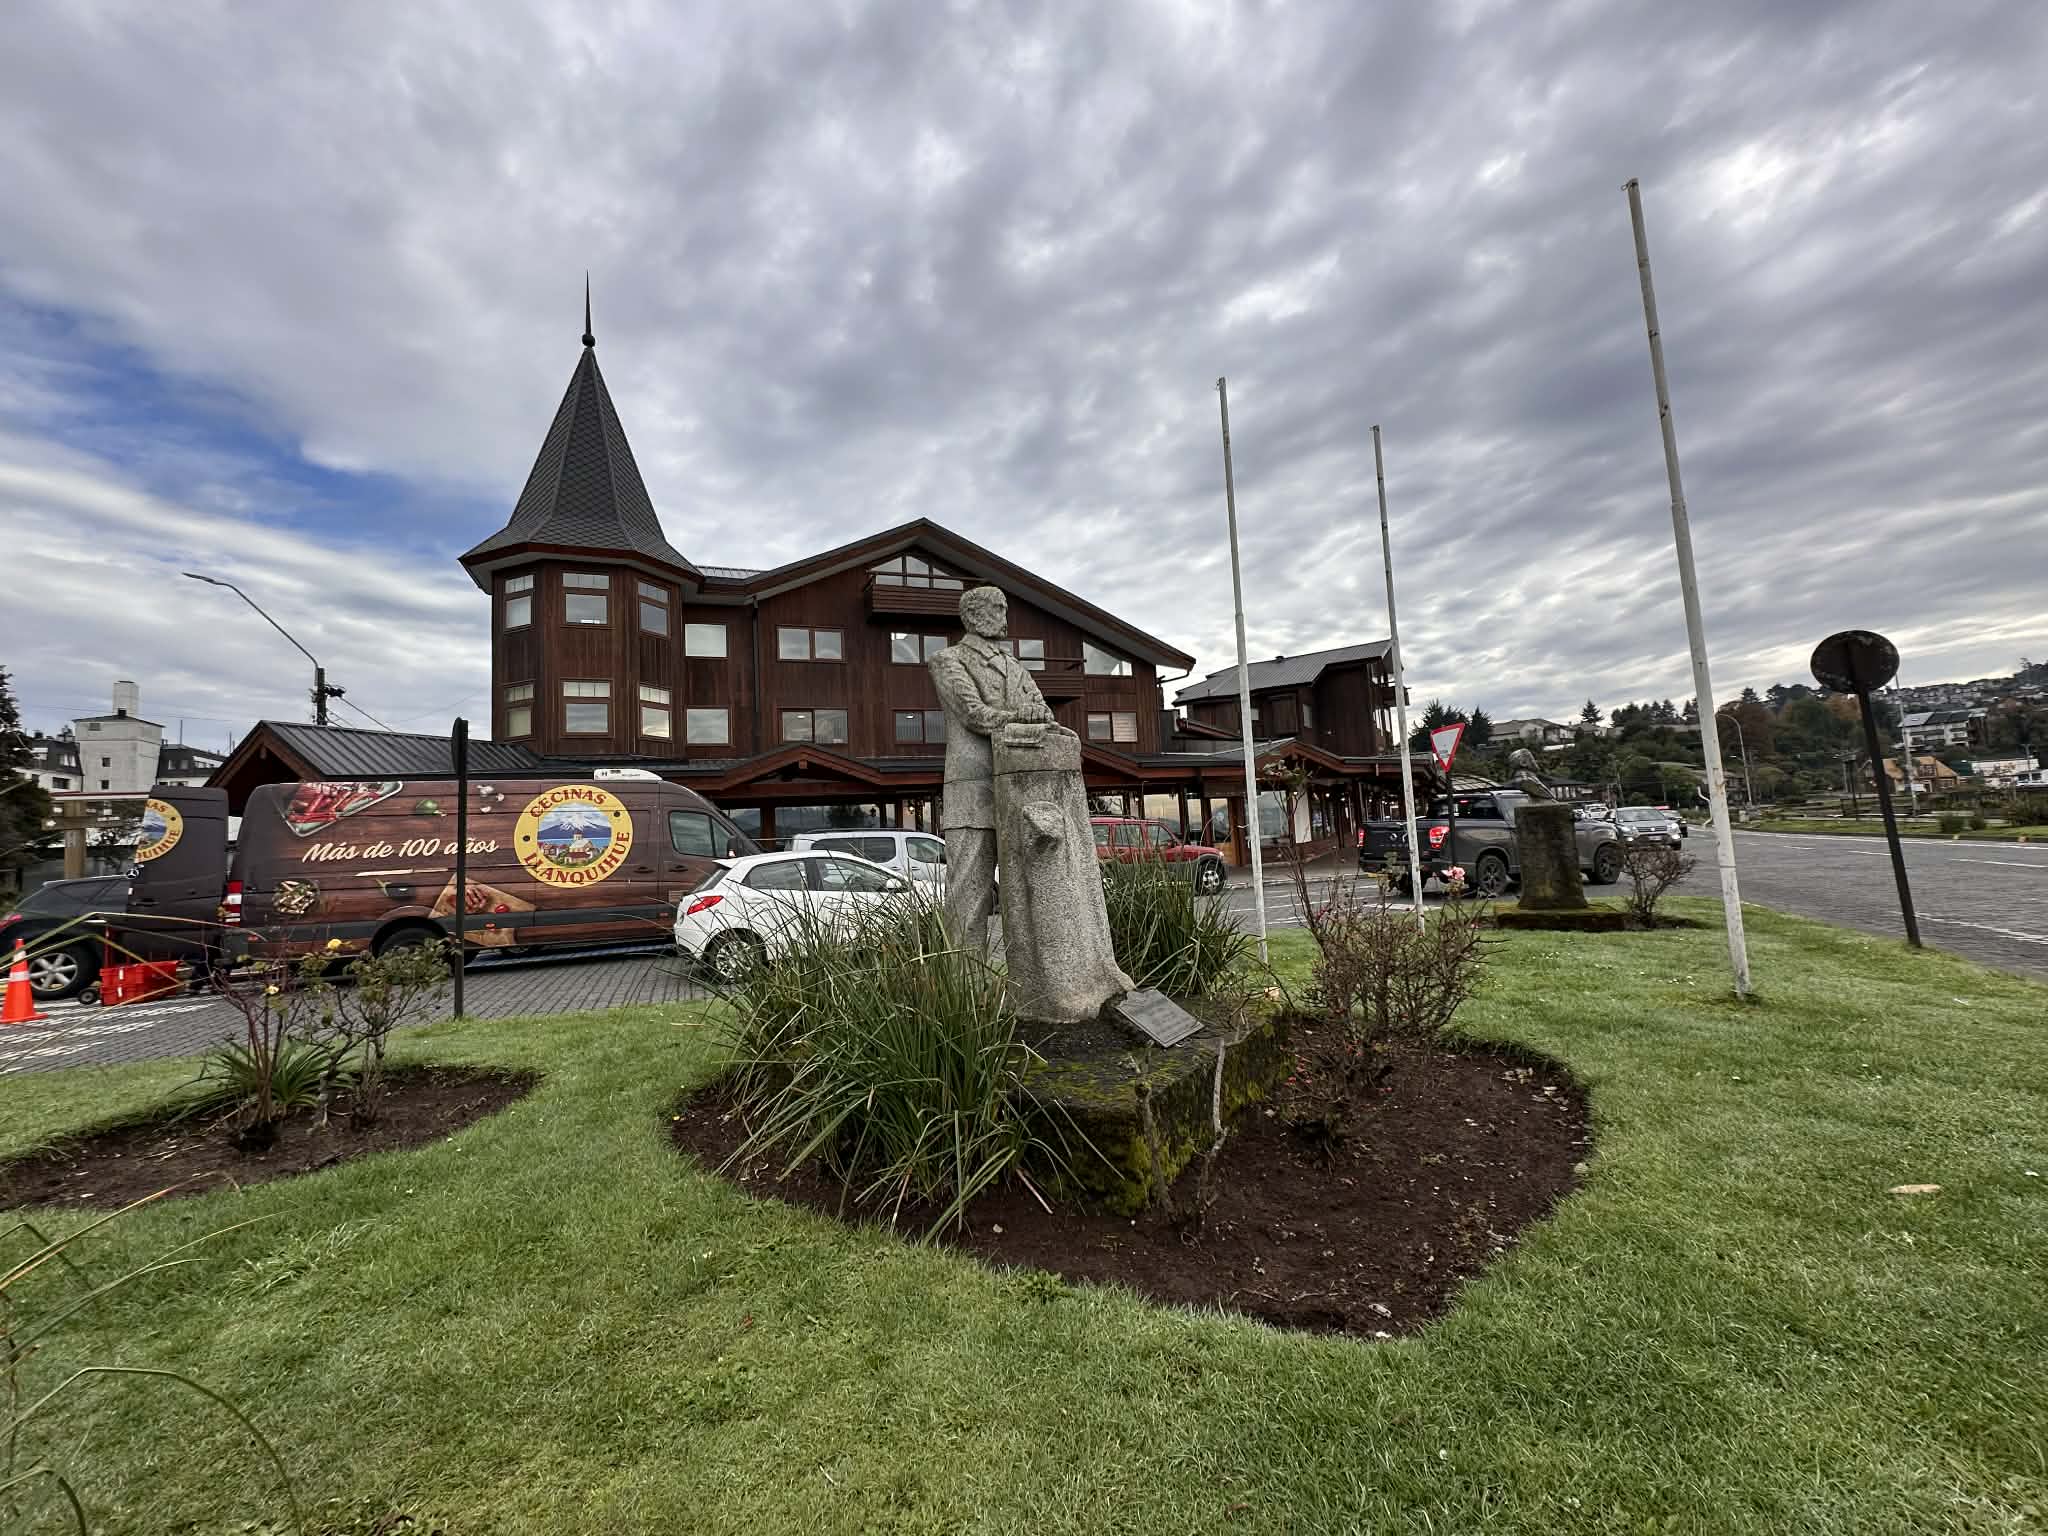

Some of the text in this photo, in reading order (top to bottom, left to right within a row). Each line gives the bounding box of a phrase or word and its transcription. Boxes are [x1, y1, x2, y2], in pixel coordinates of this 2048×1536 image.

[530, 788, 607, 818] CECINAS
[302, 841, 360, 863] Más
[362, 840, 395, 859] de
[399, 838, 441, 857] 100
[524, 831, 630, 885] LLANQUIHUE
